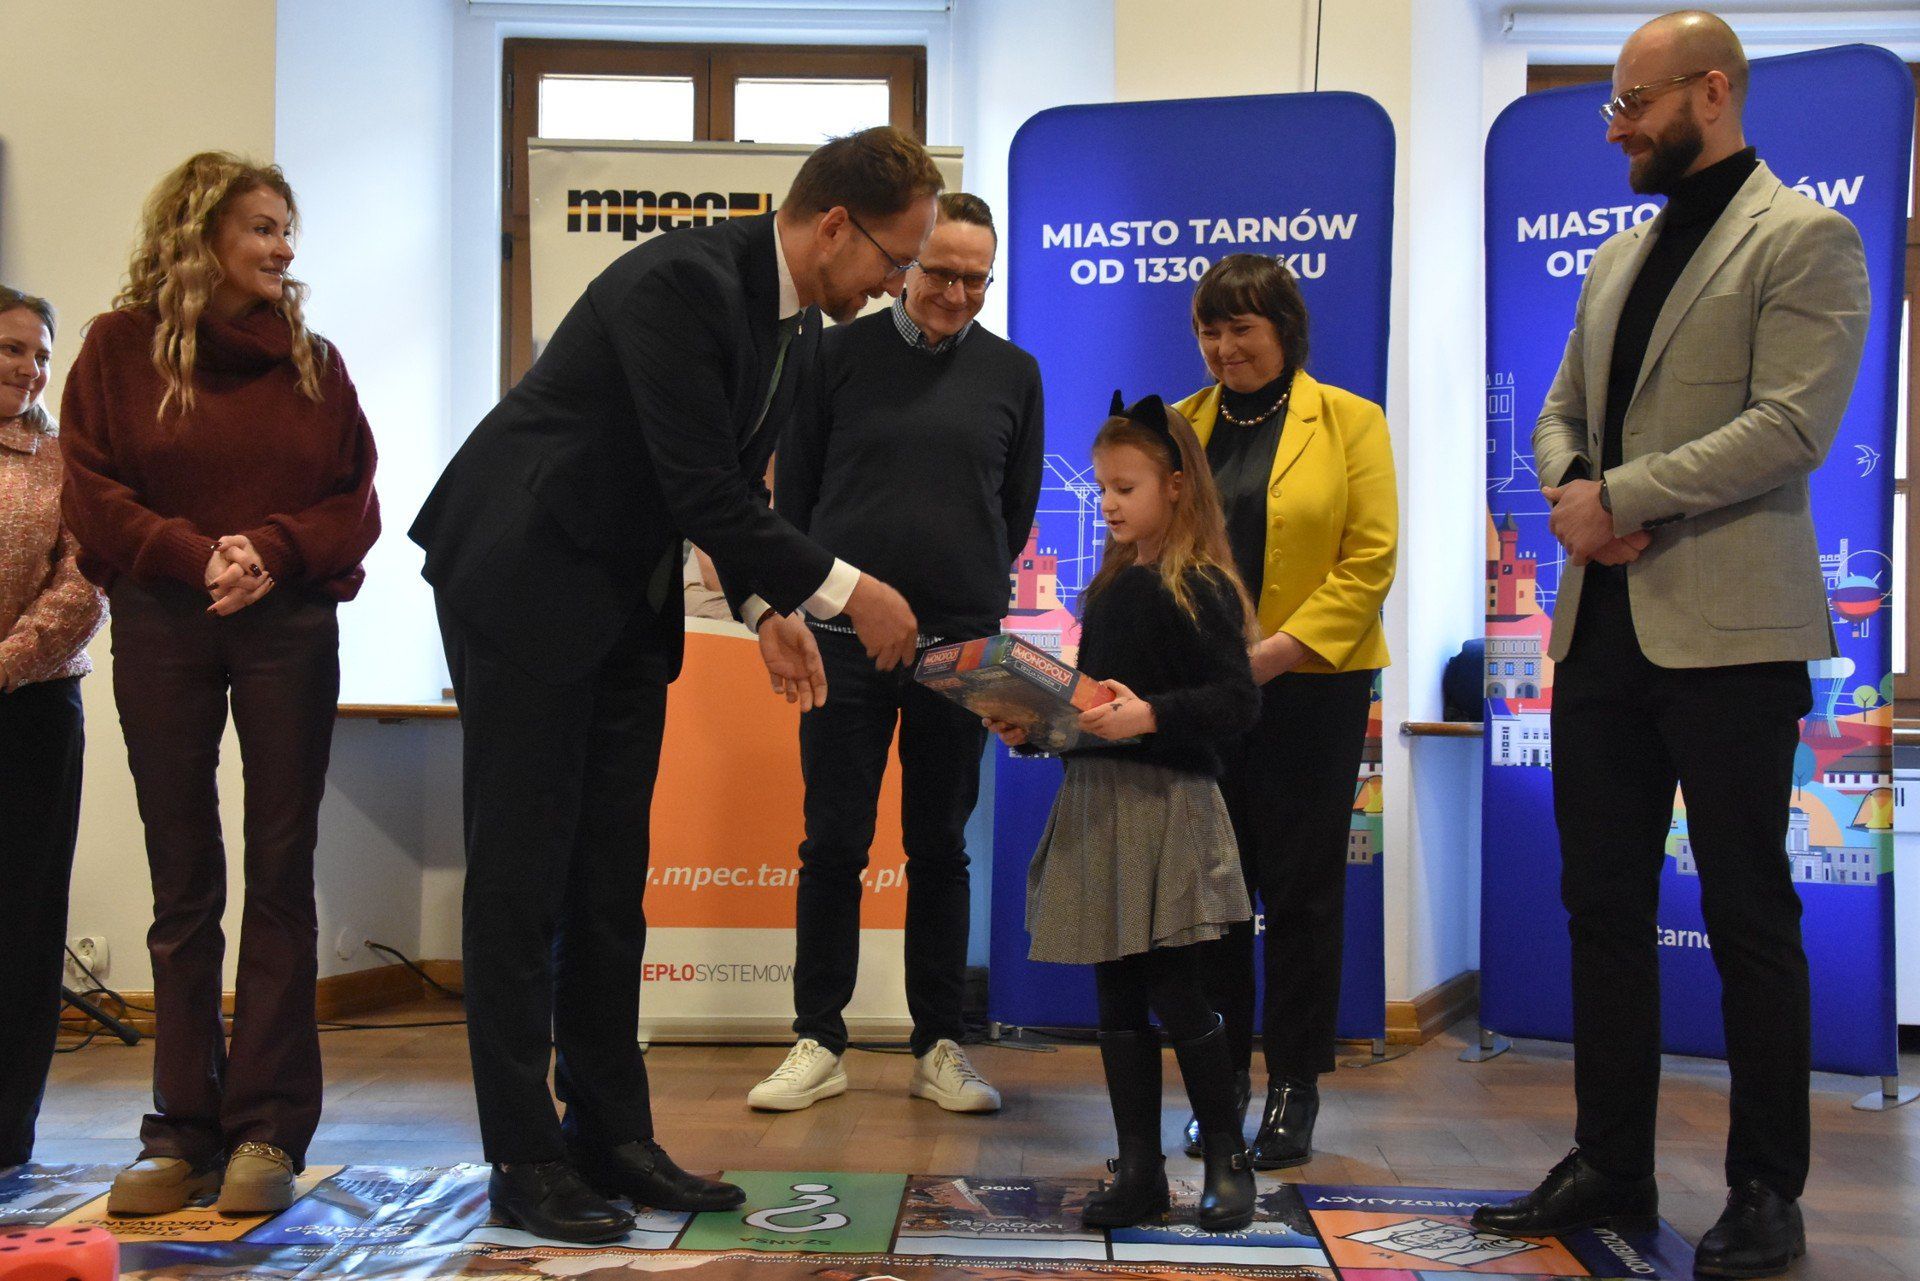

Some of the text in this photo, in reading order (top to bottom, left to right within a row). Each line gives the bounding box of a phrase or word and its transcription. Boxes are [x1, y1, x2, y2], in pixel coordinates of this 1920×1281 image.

[567, 189, 727, 241] mpec
[1042, 208, 1358, 249] MIASTO TARNÓW
[1517, 203, 1662, 243] MIASTO
[1070, 258, 1124, 285] OD
[1134, 256, 1211, 283] 1330
[1014, 647, 1072, 685] MONOPOLY
[740, 1237, 833, 1246] SZANSA
